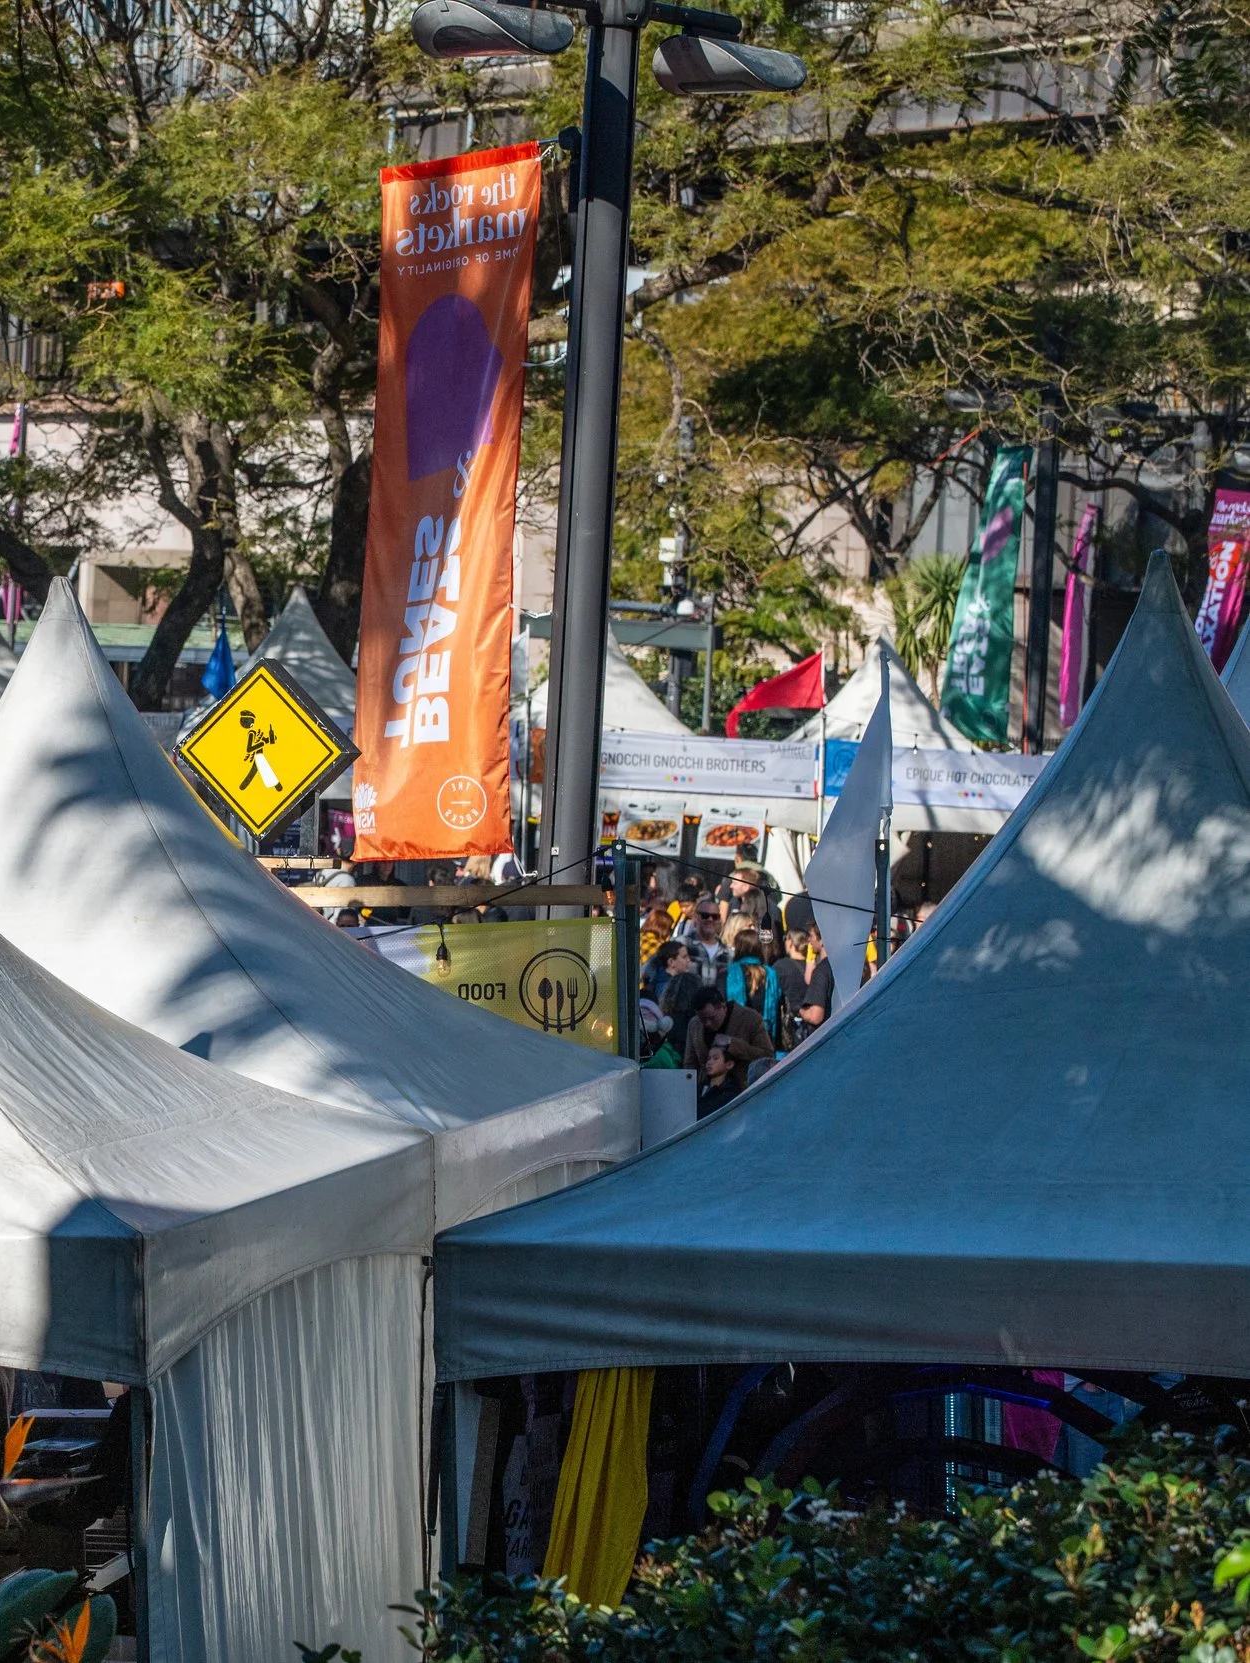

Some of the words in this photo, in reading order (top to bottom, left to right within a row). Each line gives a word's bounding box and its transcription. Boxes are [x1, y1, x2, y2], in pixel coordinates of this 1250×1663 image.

[601, 751, 651, 767] GNOCCHI
[653, 755, 704, 770] GNOCCHI
[706, 757, 766, 773] BROTHERS
[906, 767, 945, 783] EPIQUE
[946, 770, 967, 784] HOT
[970, 772, 1035, 788] CHOCOLATE
